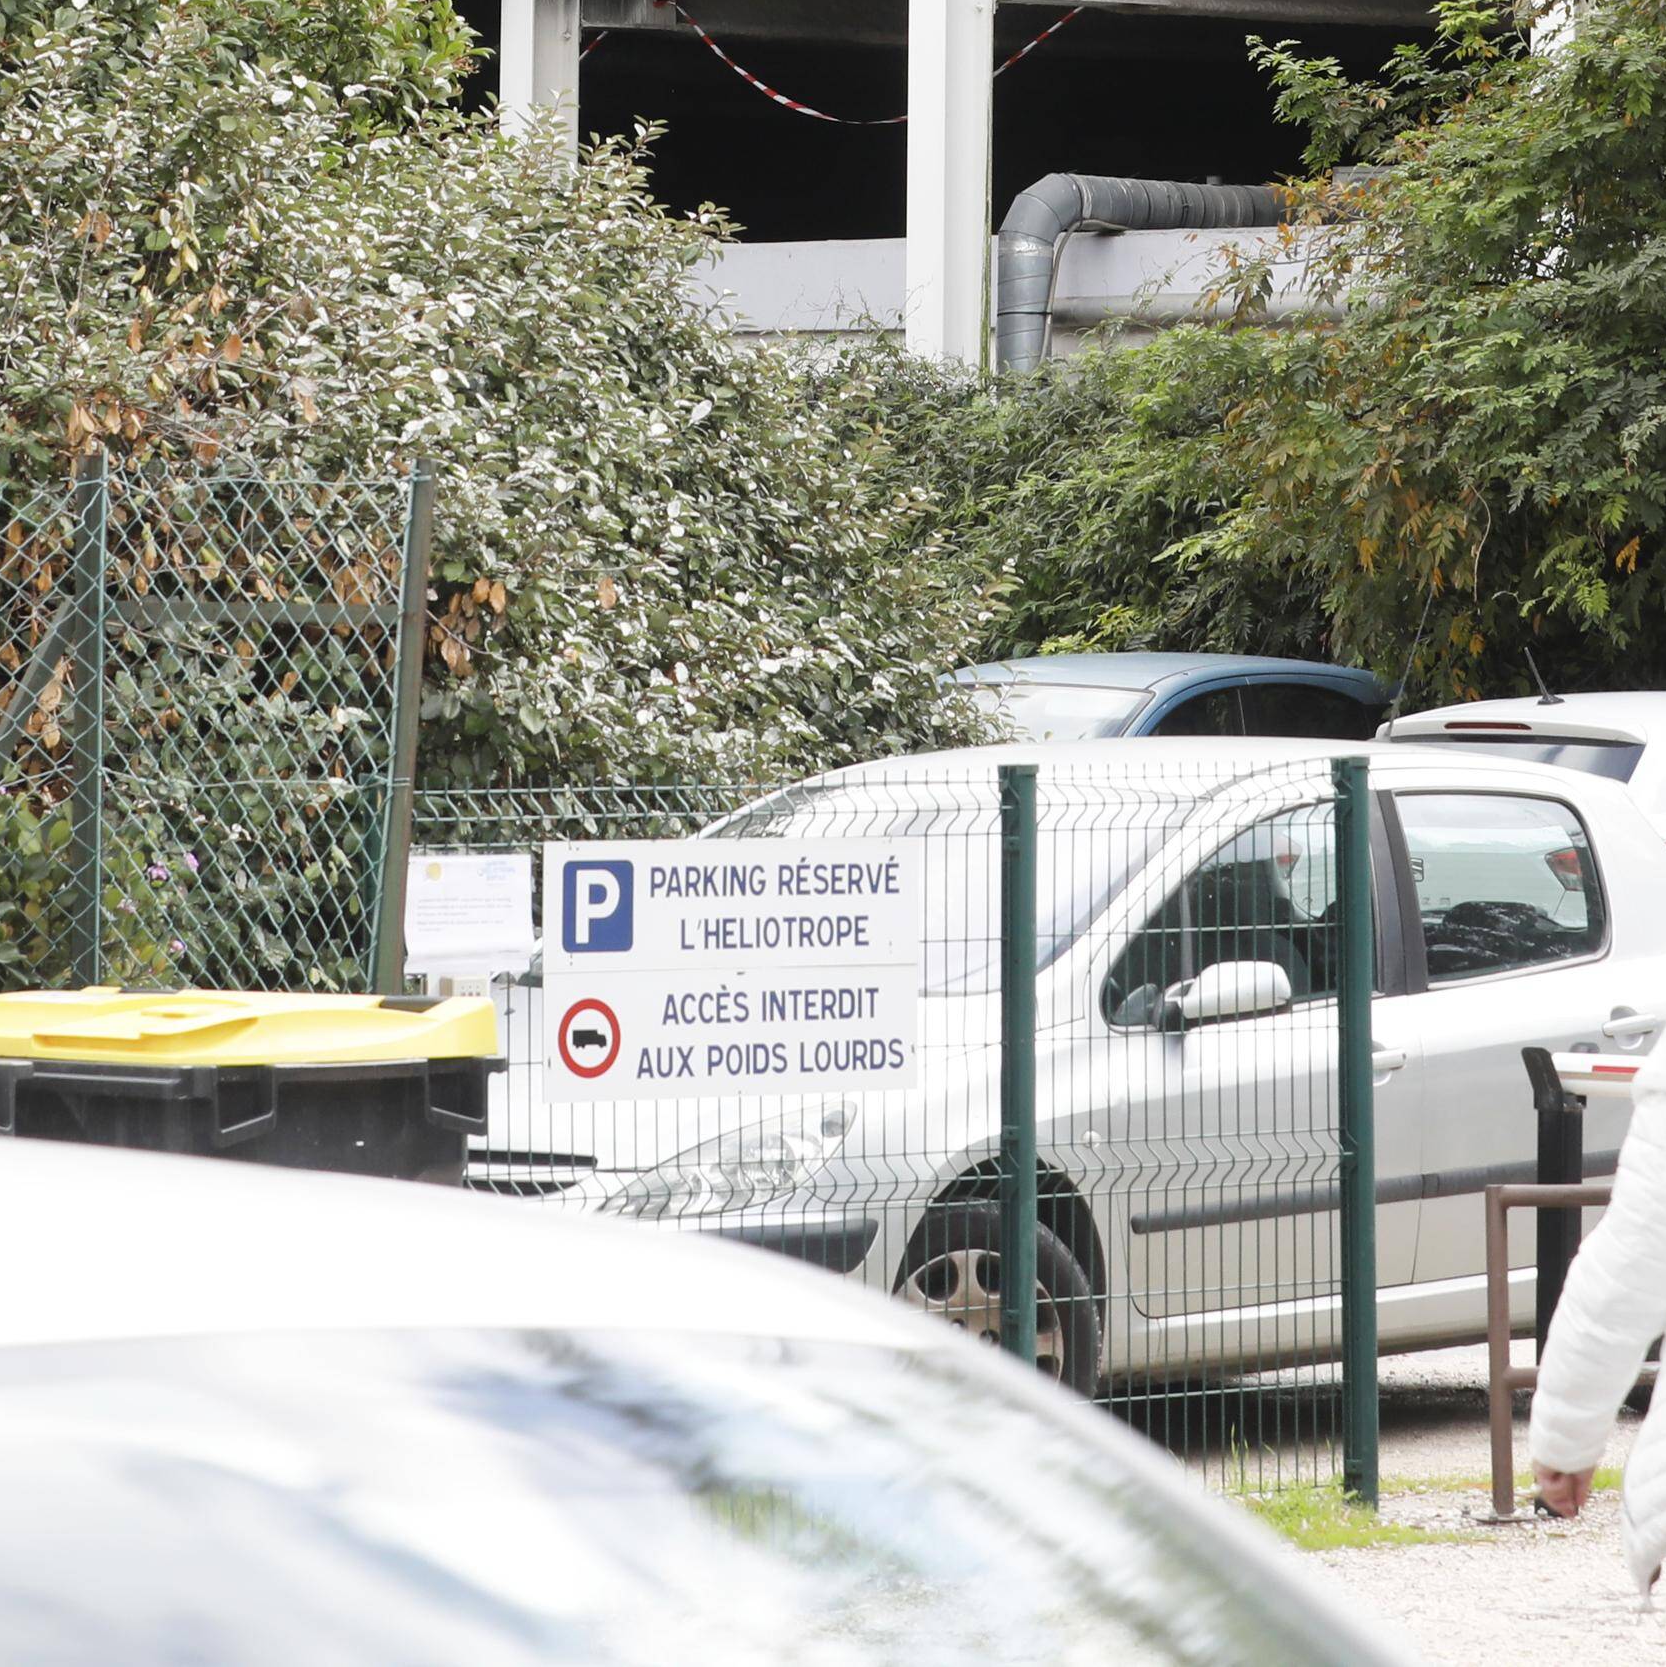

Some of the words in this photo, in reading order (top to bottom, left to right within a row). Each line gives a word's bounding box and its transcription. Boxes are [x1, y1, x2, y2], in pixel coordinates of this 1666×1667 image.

[649, 864, 767, 899] PARKING
[777, 855, 901, 896] RÉSERVÉ
[574, 868, 621, 945] P
[679, 915, 871, 951] L'HELIOTROPE
[661, 984, 751, 1026] ACCÈS
[761, 986, 880, 1022] INTERDIT
[635, 1045, 696, 1080] AUX
[706, 1042, 789, 1077] POIDS
[798, 1038, 906, 1073] LOURDS
